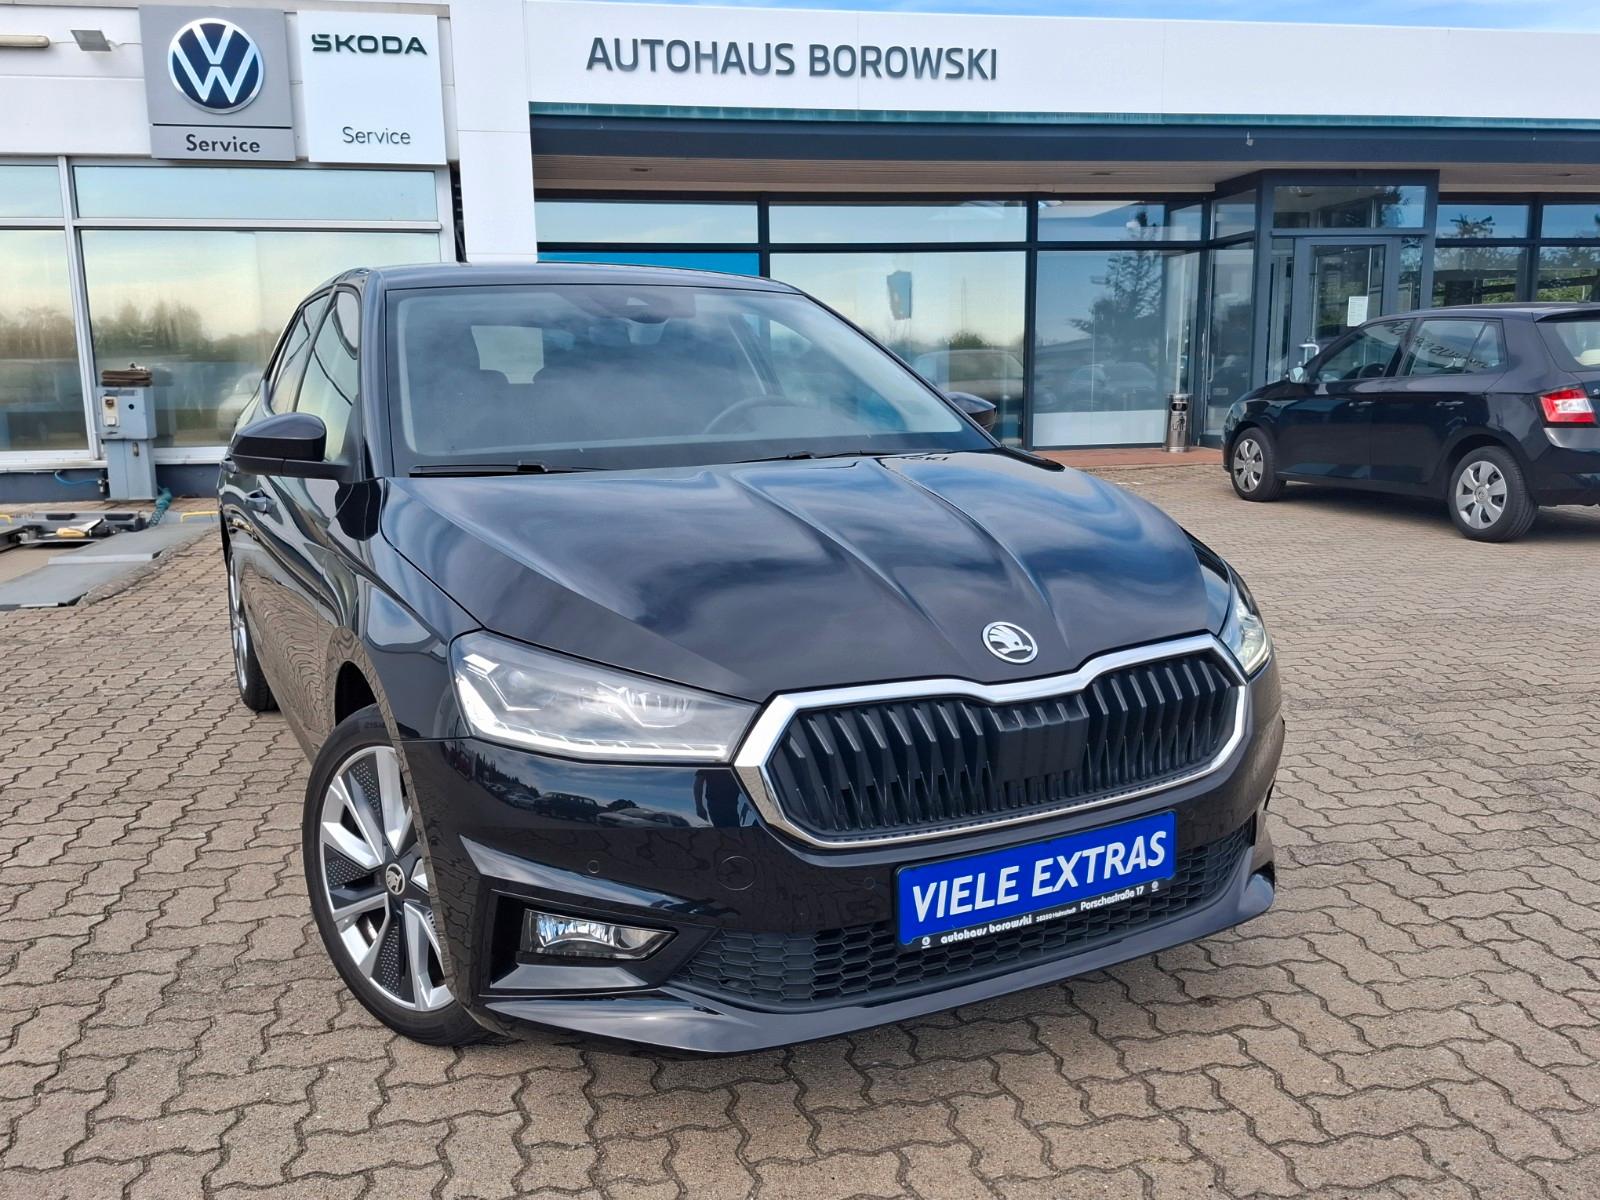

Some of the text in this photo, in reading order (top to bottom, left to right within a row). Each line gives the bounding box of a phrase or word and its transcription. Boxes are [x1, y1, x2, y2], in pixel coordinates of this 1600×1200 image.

[586, 37, 998, 80] AUTOHAUS BOROWSKI
[186, 134, 261, 153] Service
[342, 126, 411, 145] Service
[912, 831, 1167, 923] VIELE EXTRAS
[940, 926, 988, 944] autohaus
[988, 914, 1033, 934] borowski
[1080, 889, 1135, 911] Porschestraße
[1135, 885, 1145, 896] 17
